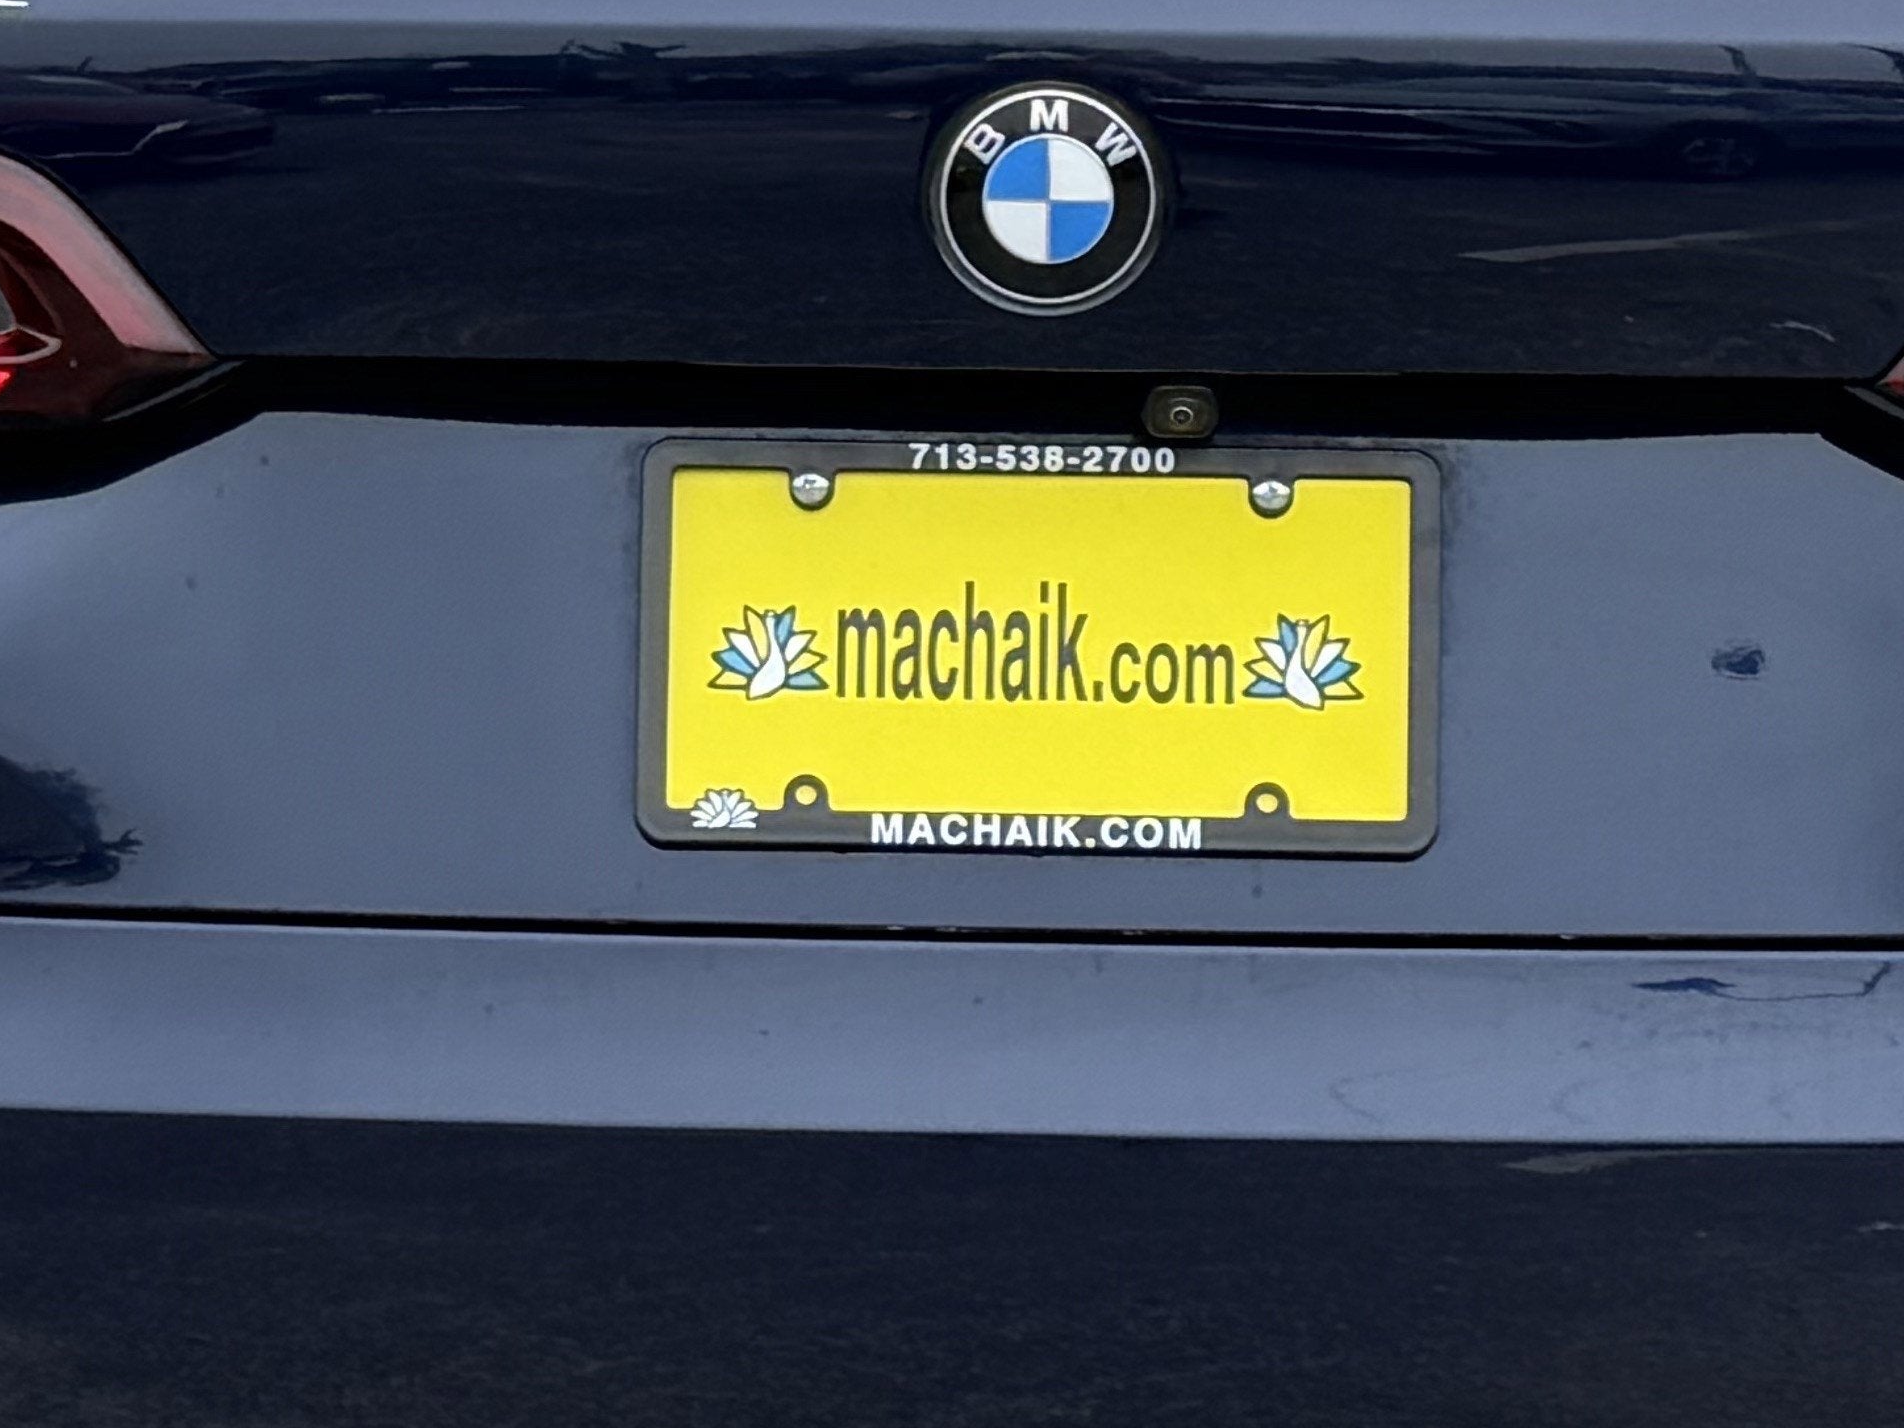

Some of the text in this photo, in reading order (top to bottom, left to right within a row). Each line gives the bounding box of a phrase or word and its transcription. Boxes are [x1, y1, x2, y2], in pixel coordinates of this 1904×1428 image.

[963, 98, 1138, 167] BMW
[908, 442, 1176, 473] 713-538-2700
[836, 580, 1236, 706] machaik.com
[869, 813, 1202, 850] MACHAIK.COM
